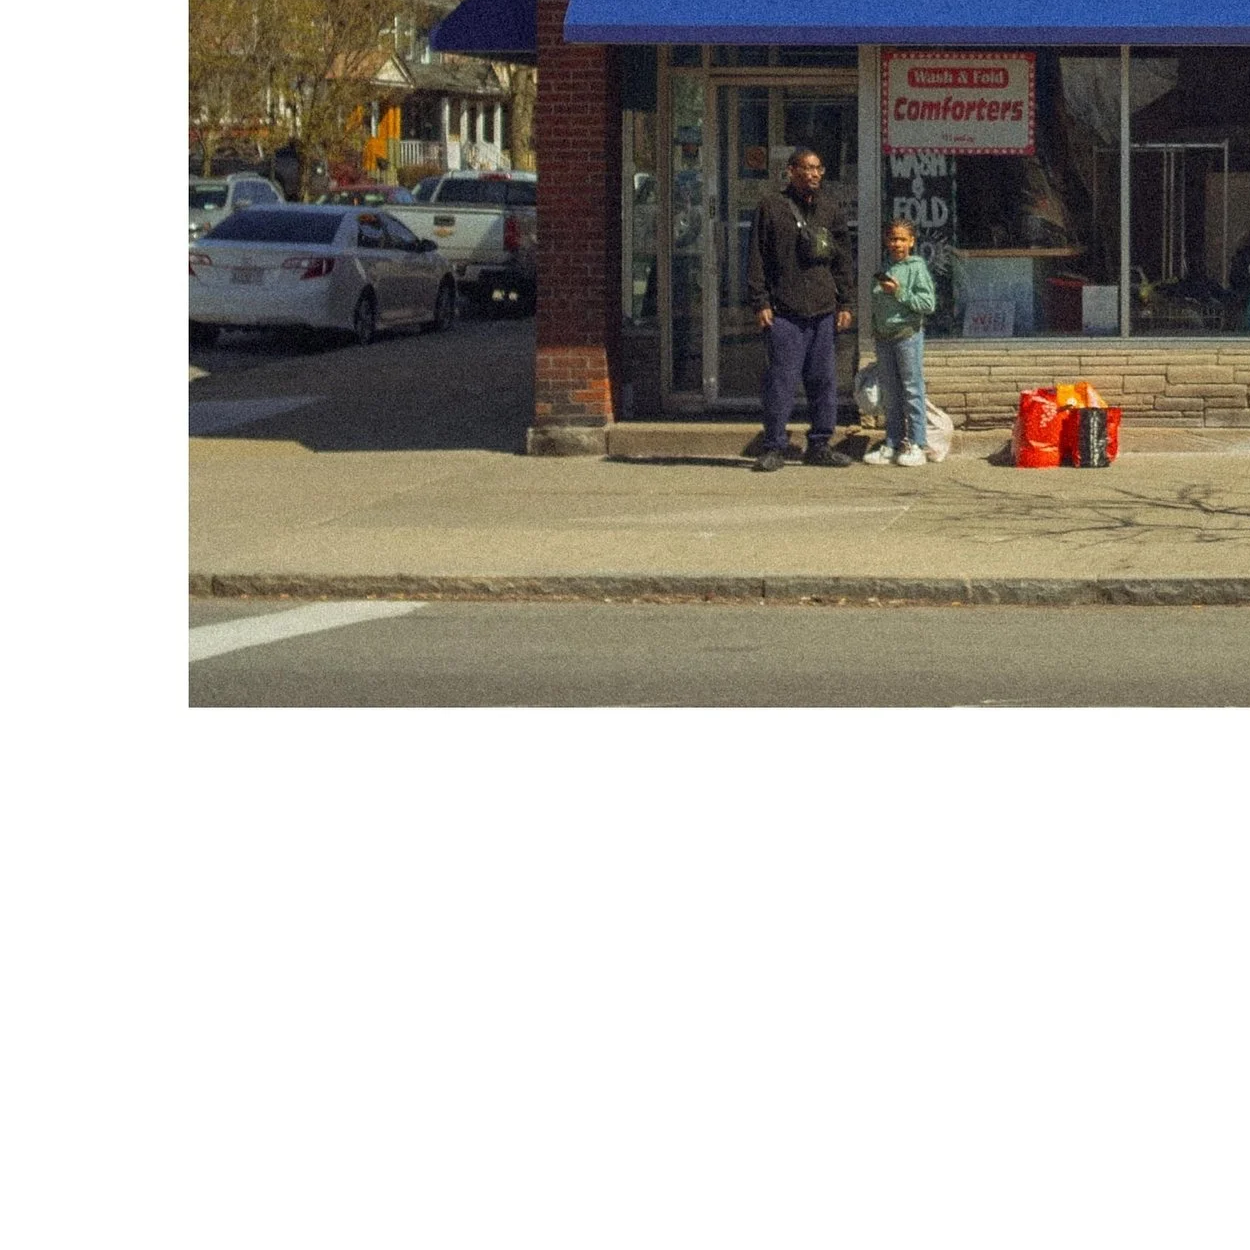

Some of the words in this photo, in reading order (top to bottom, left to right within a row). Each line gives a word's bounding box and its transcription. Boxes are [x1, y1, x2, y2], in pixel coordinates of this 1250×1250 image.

[914, 69, 953, 84] Wash
[957, 69, 969, 84] &
[973, 69, 1004, 84] Fold
[893, 96, 1024, 122] Comforters
[889, 151, 948, 178] WASH
[892, 196, 949, 228] FOLD
